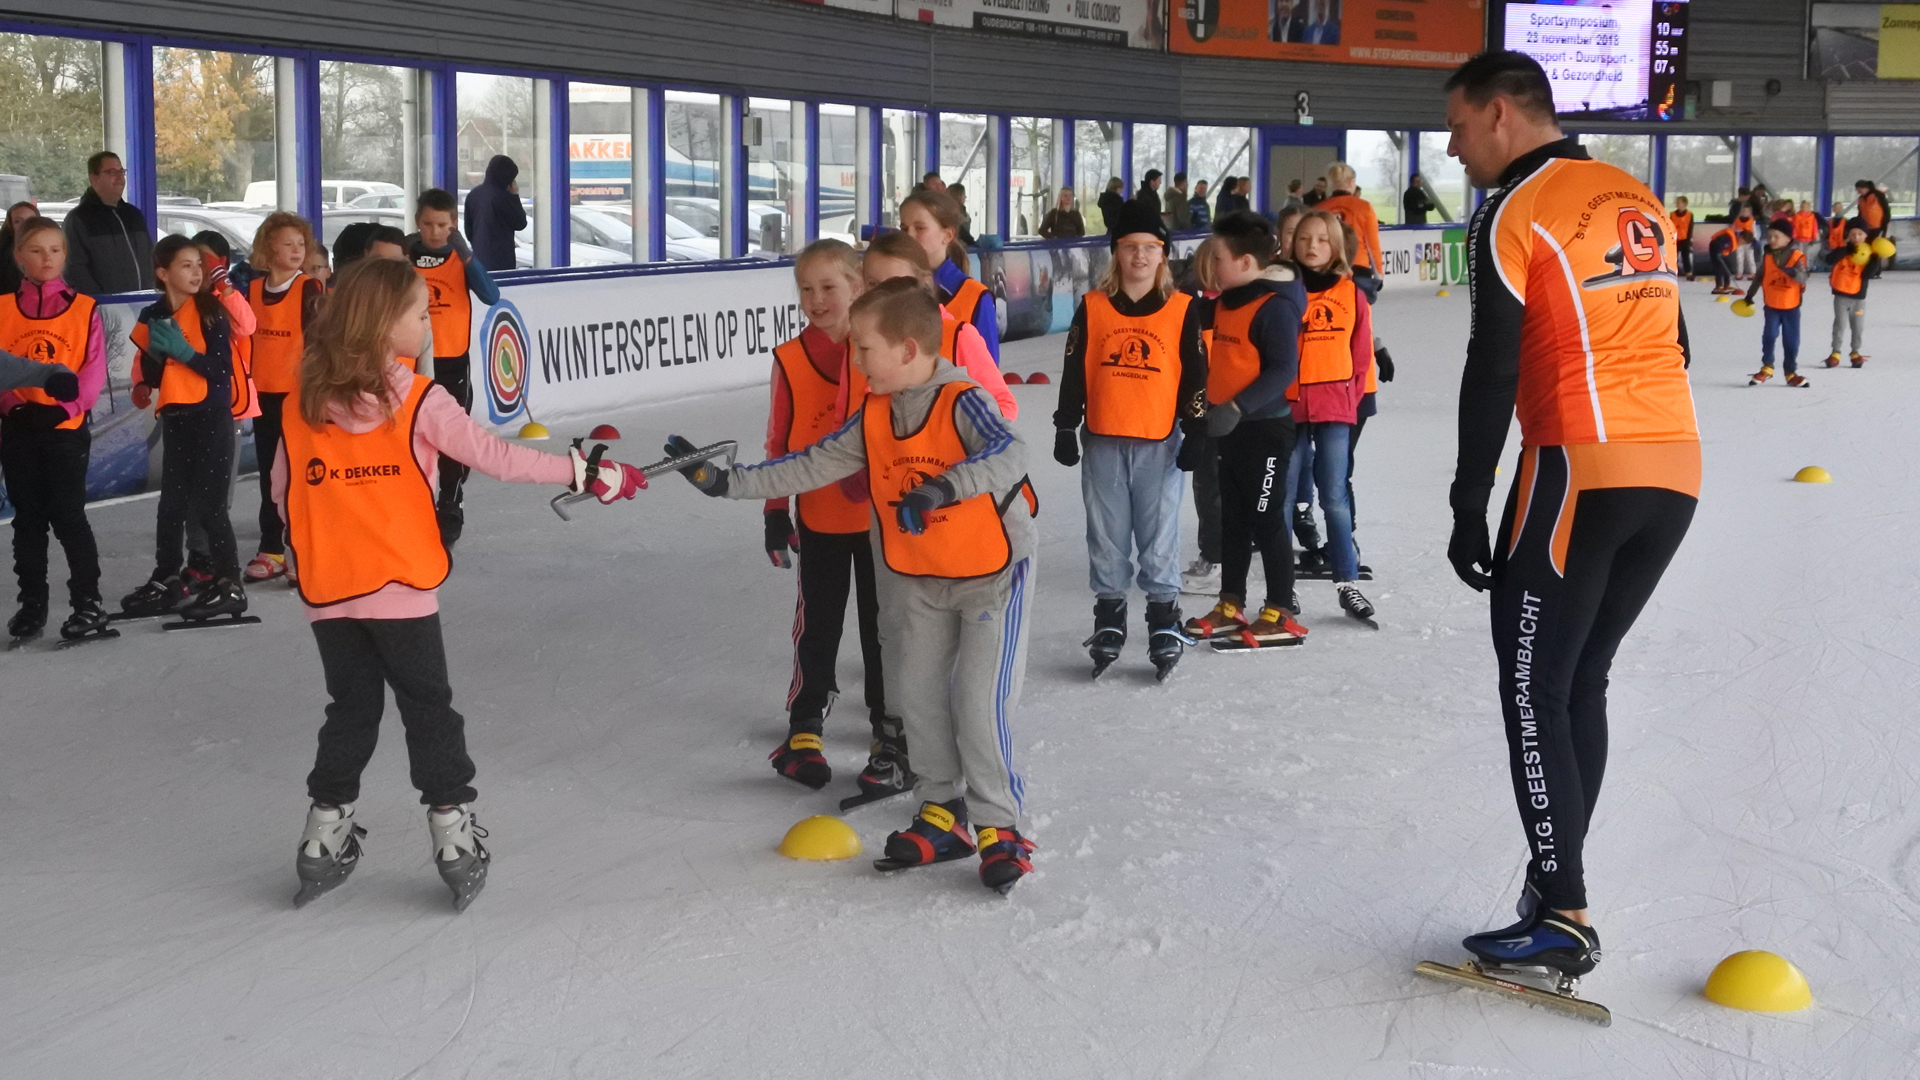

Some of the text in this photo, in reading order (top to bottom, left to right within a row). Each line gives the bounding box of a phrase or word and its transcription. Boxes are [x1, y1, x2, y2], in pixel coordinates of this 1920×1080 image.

[1074, 0, 1121, 23] FULL COLOURS
[981, 16, 1024, 30] OUDEGRACHT
[1530, 13, 1618, 28] Sportsymposium
[1656, 22, 1671, 36] 10
[1527, 31, 1620, 46] 23 november 2018
[1655, 41, 1669, 56] 55
[1576, 50, 1627, 66] Duursport
[1654, 60, 1668, 74] 07
[1562, 68, 1623, 82] Gezondheid
[1297, 91, 1309, 117] 3
[1576, 191, 1675, 246] S.T.G. GEESTMERAMBA
[1617, 286, 1673, 304] LANGEDIJK
[538, 312, 709, 384] WINTERSPELEN
[715, 310, 738, 359] OP
[745, 307, 769, 355] DE
[1112, 370, 1149, 380] LANGEDIJK
[1257, 456, 1277, 512] GIVOVA
[1514, 590, 1557, 872] GEESTMERAMBACHT S.T.G.
